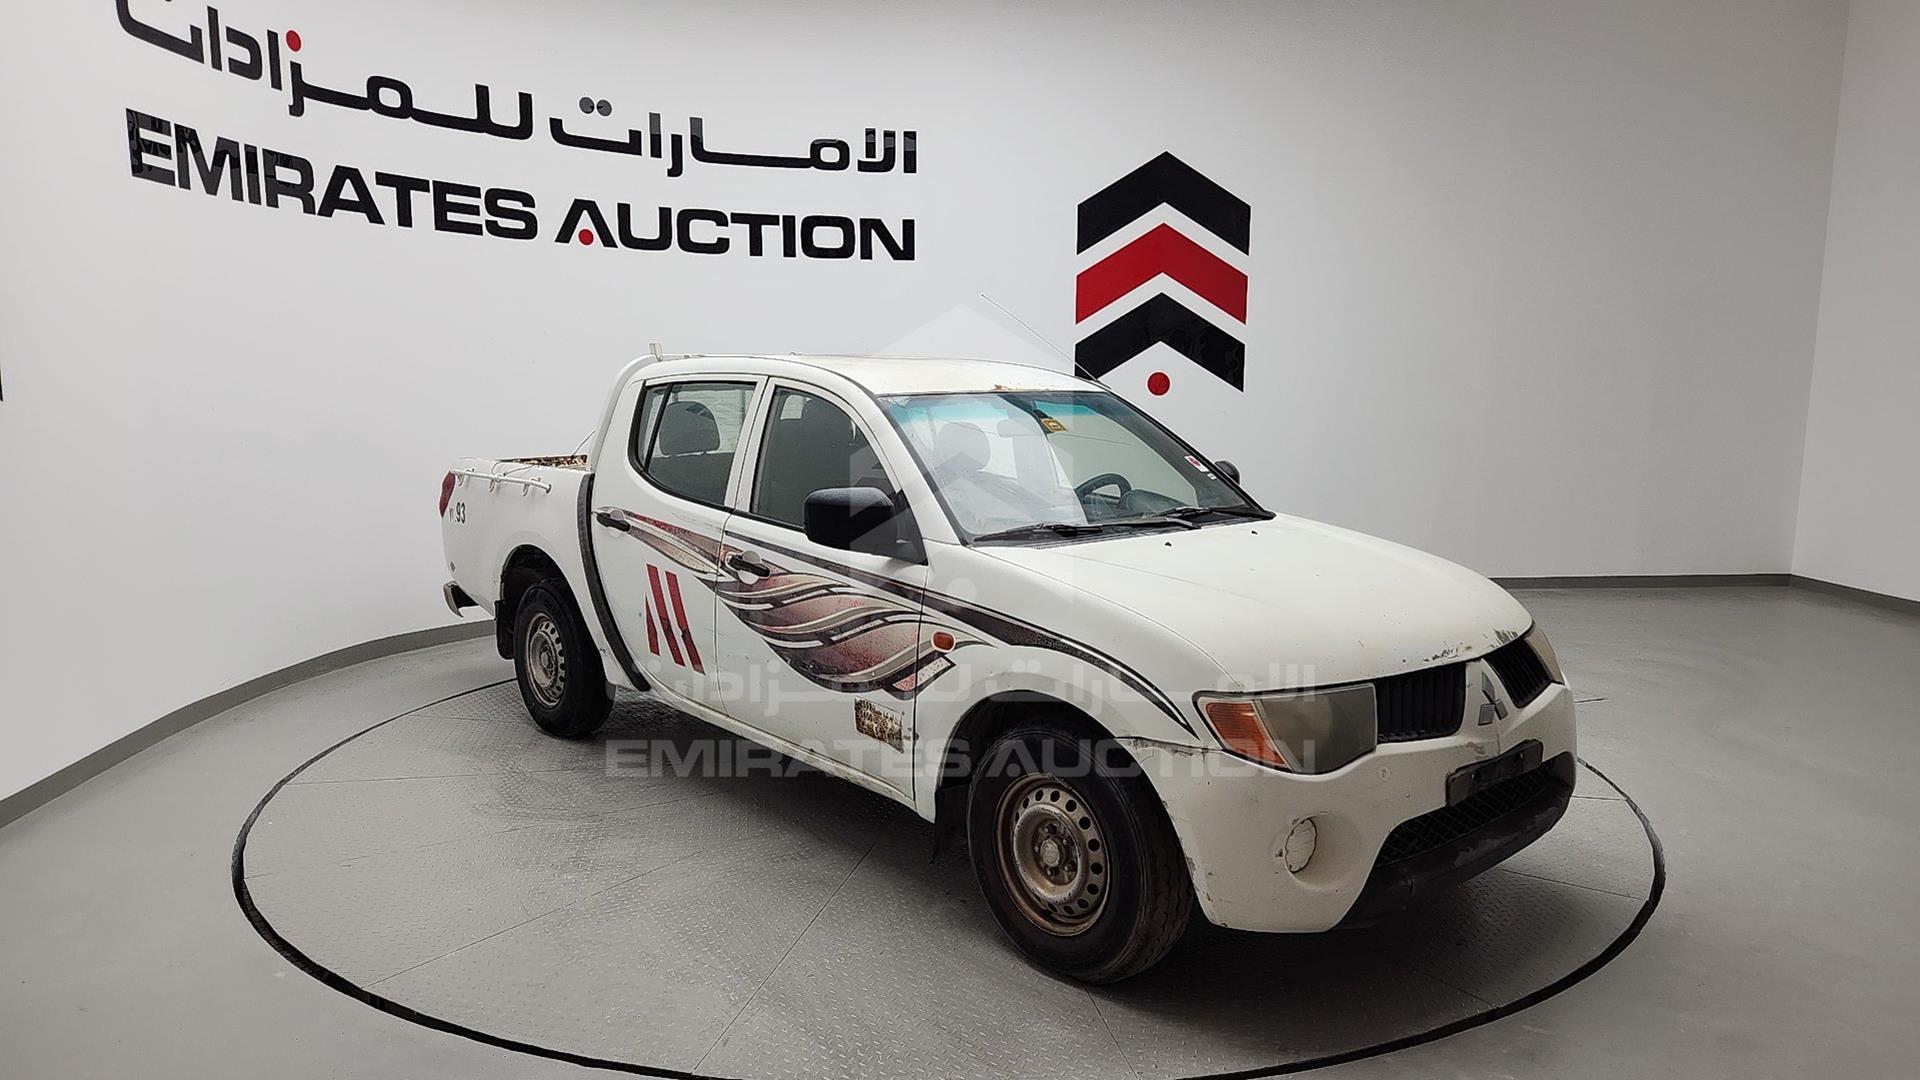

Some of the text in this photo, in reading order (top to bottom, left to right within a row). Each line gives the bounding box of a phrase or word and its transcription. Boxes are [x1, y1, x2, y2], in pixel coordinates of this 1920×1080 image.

[125, 108, 916, 261] EMIRATES AUCTION
[549, 96, 917, 178] الامارات
